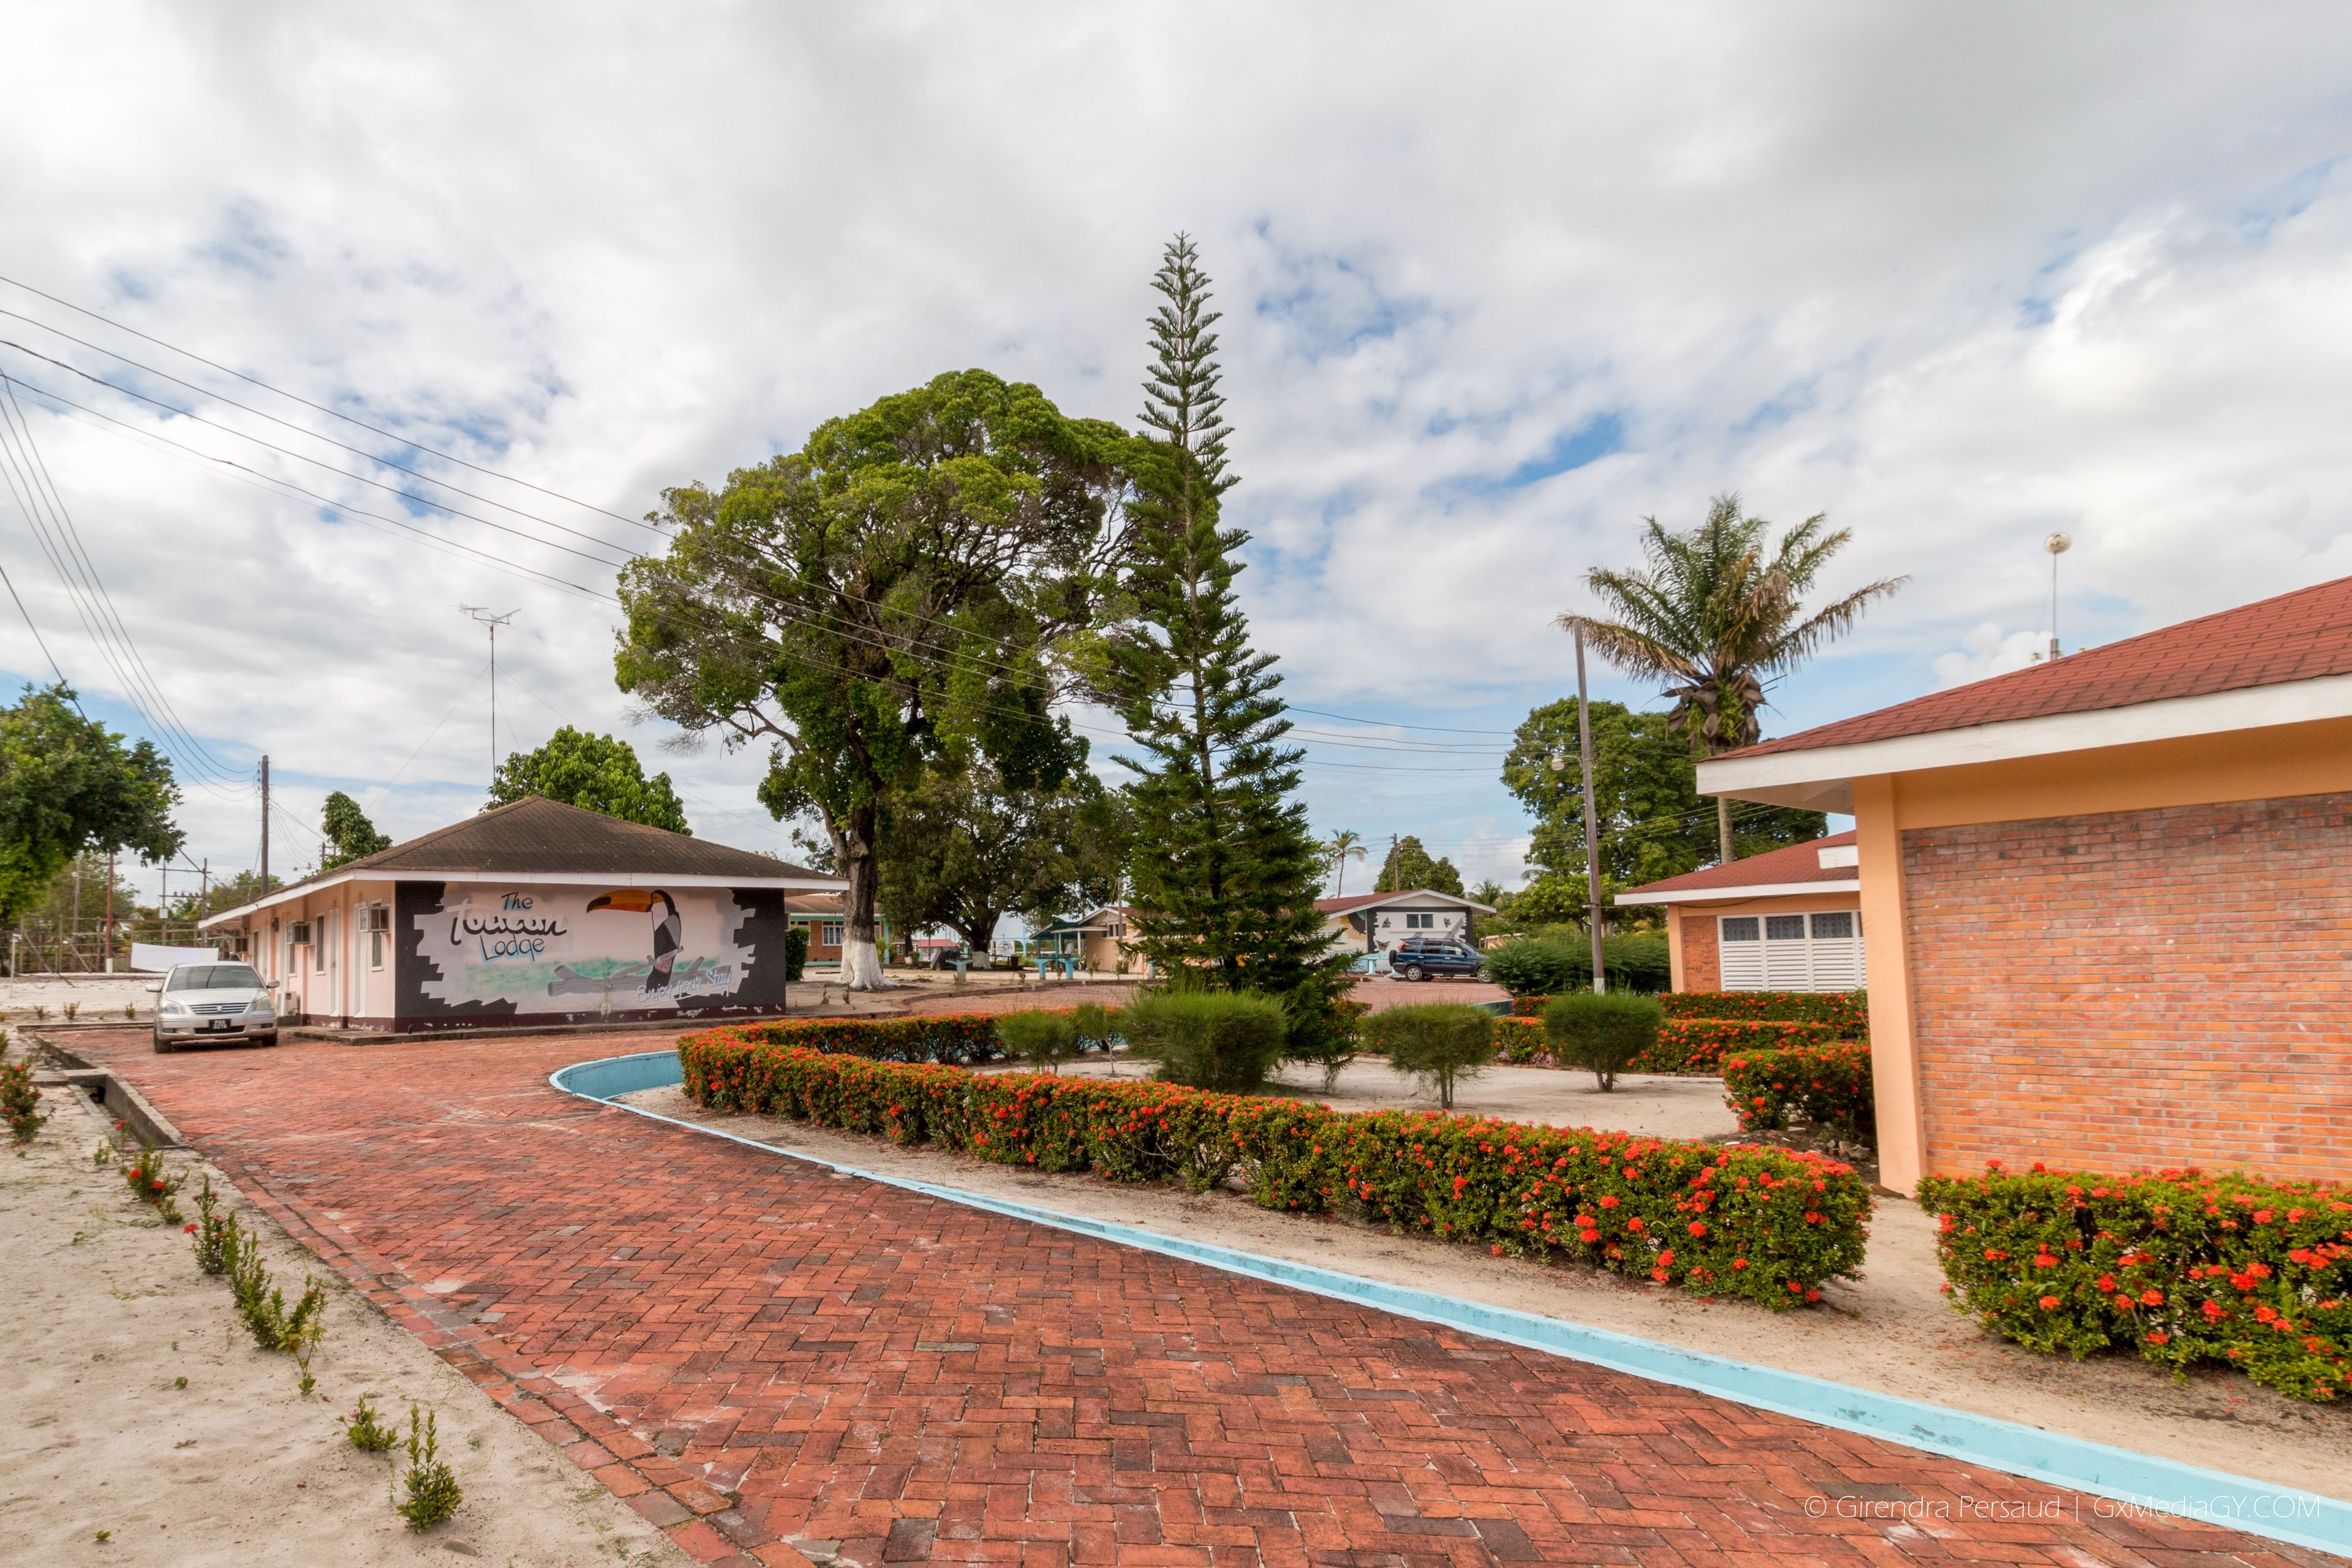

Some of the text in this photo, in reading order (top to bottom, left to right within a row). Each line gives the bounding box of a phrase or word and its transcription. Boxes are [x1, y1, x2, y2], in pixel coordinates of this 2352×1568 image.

[501, 892, 533, 910] The
[446, 898, 567, 946] Toucan
[480, 933, 545, 962] Lodge
[637, 969, 731, 1003] Enjoy your Stay
